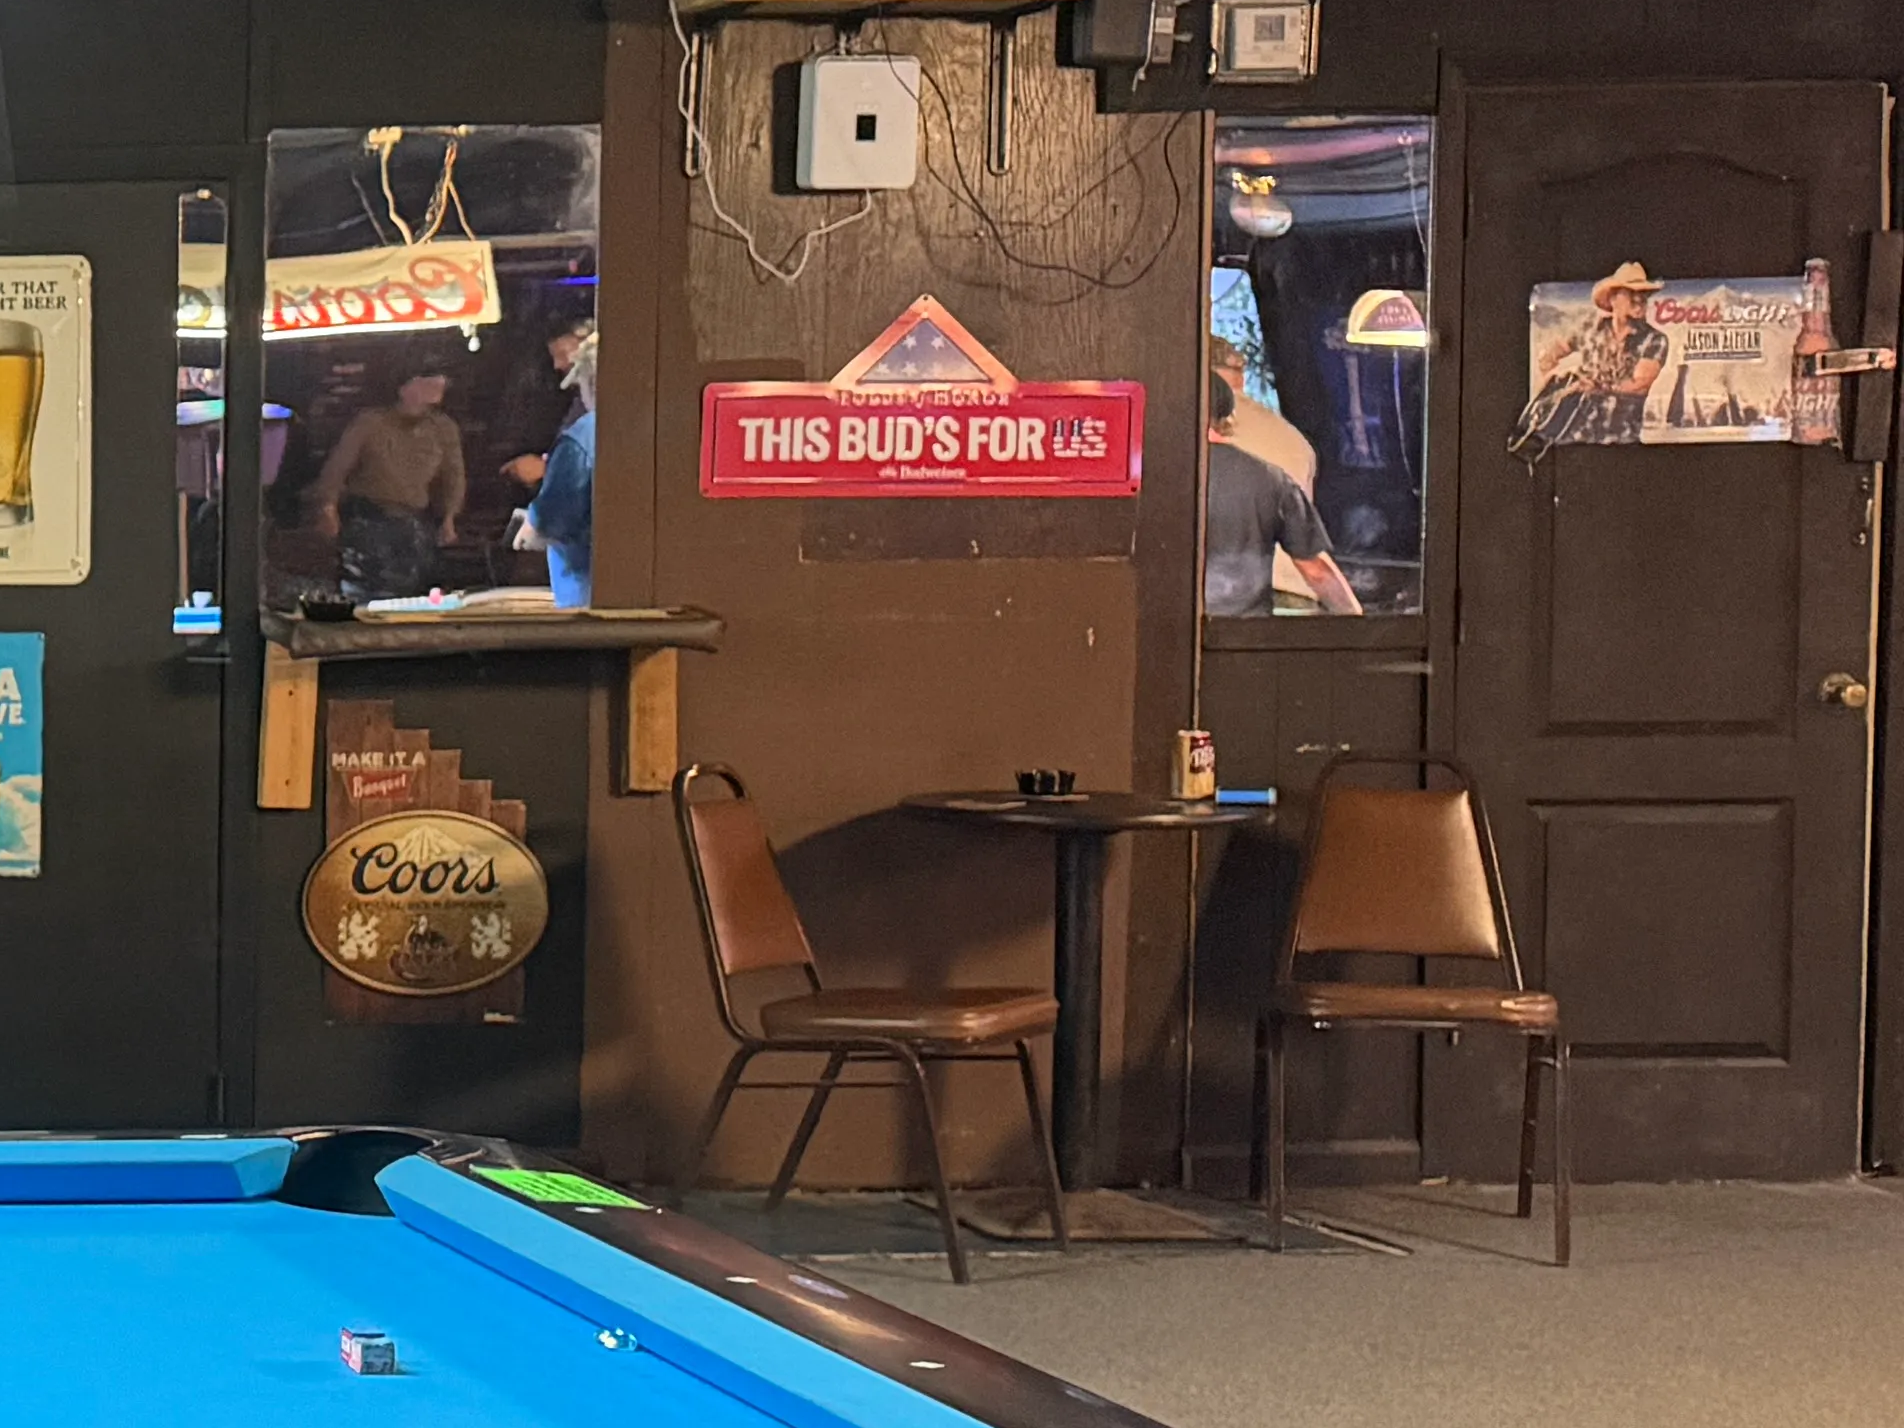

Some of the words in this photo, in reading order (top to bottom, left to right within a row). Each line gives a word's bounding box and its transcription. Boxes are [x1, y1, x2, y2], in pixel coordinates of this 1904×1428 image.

[10, 280, 59, 295] THAT
[22, 295, 69, 311] BEER
[739, 416, 831, 462] THIS
[838, 415, 961, 462] BUD'S
[967, 414, 1046, 462] FOR
[1052, 416, 1107, 458] US
[331, 751, 385, 768] MAKE
[388, 750, 408, 767] IT
[410, 750, 426, 767] A
[349, 842, 500, 895] Coors
